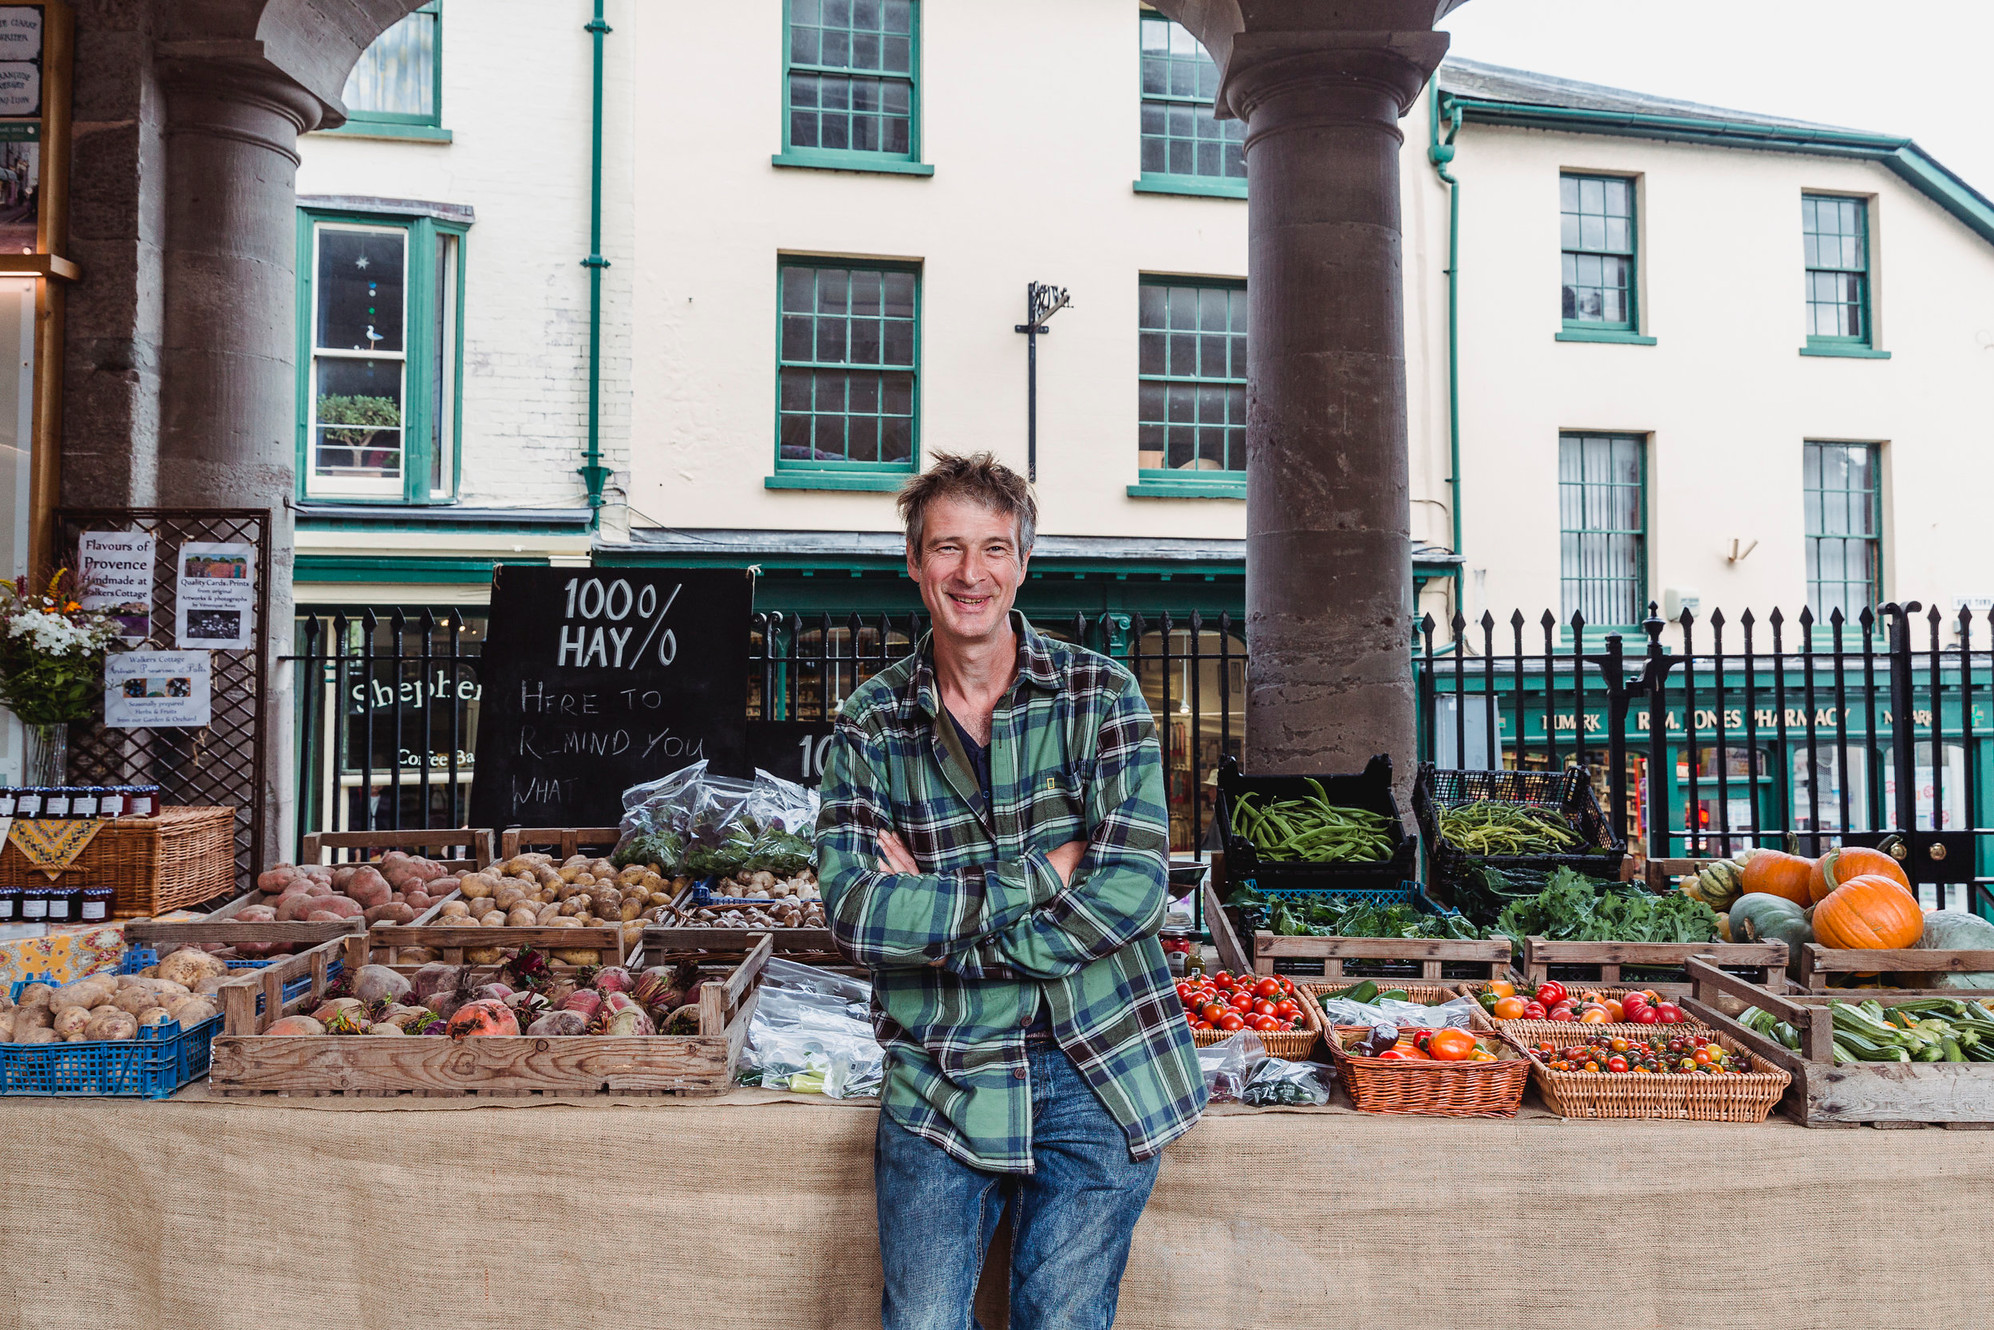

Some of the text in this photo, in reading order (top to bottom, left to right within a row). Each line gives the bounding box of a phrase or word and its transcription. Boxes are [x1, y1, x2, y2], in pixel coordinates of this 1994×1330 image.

[86, 539, 150, 551] Flavours of
[84, 556, 147, 570] Provence
[82, 575, 135, 586] Hndmade
[83, 588, 148, 600] alkers Cottage
[557, 625, 634, 668] HAY
[620, 688, 661, 709] TO
[1684, 709, 1742, 732] ONES
[642, 727, 704, 760] YOU
[399, 748, 449, 767] Coee
